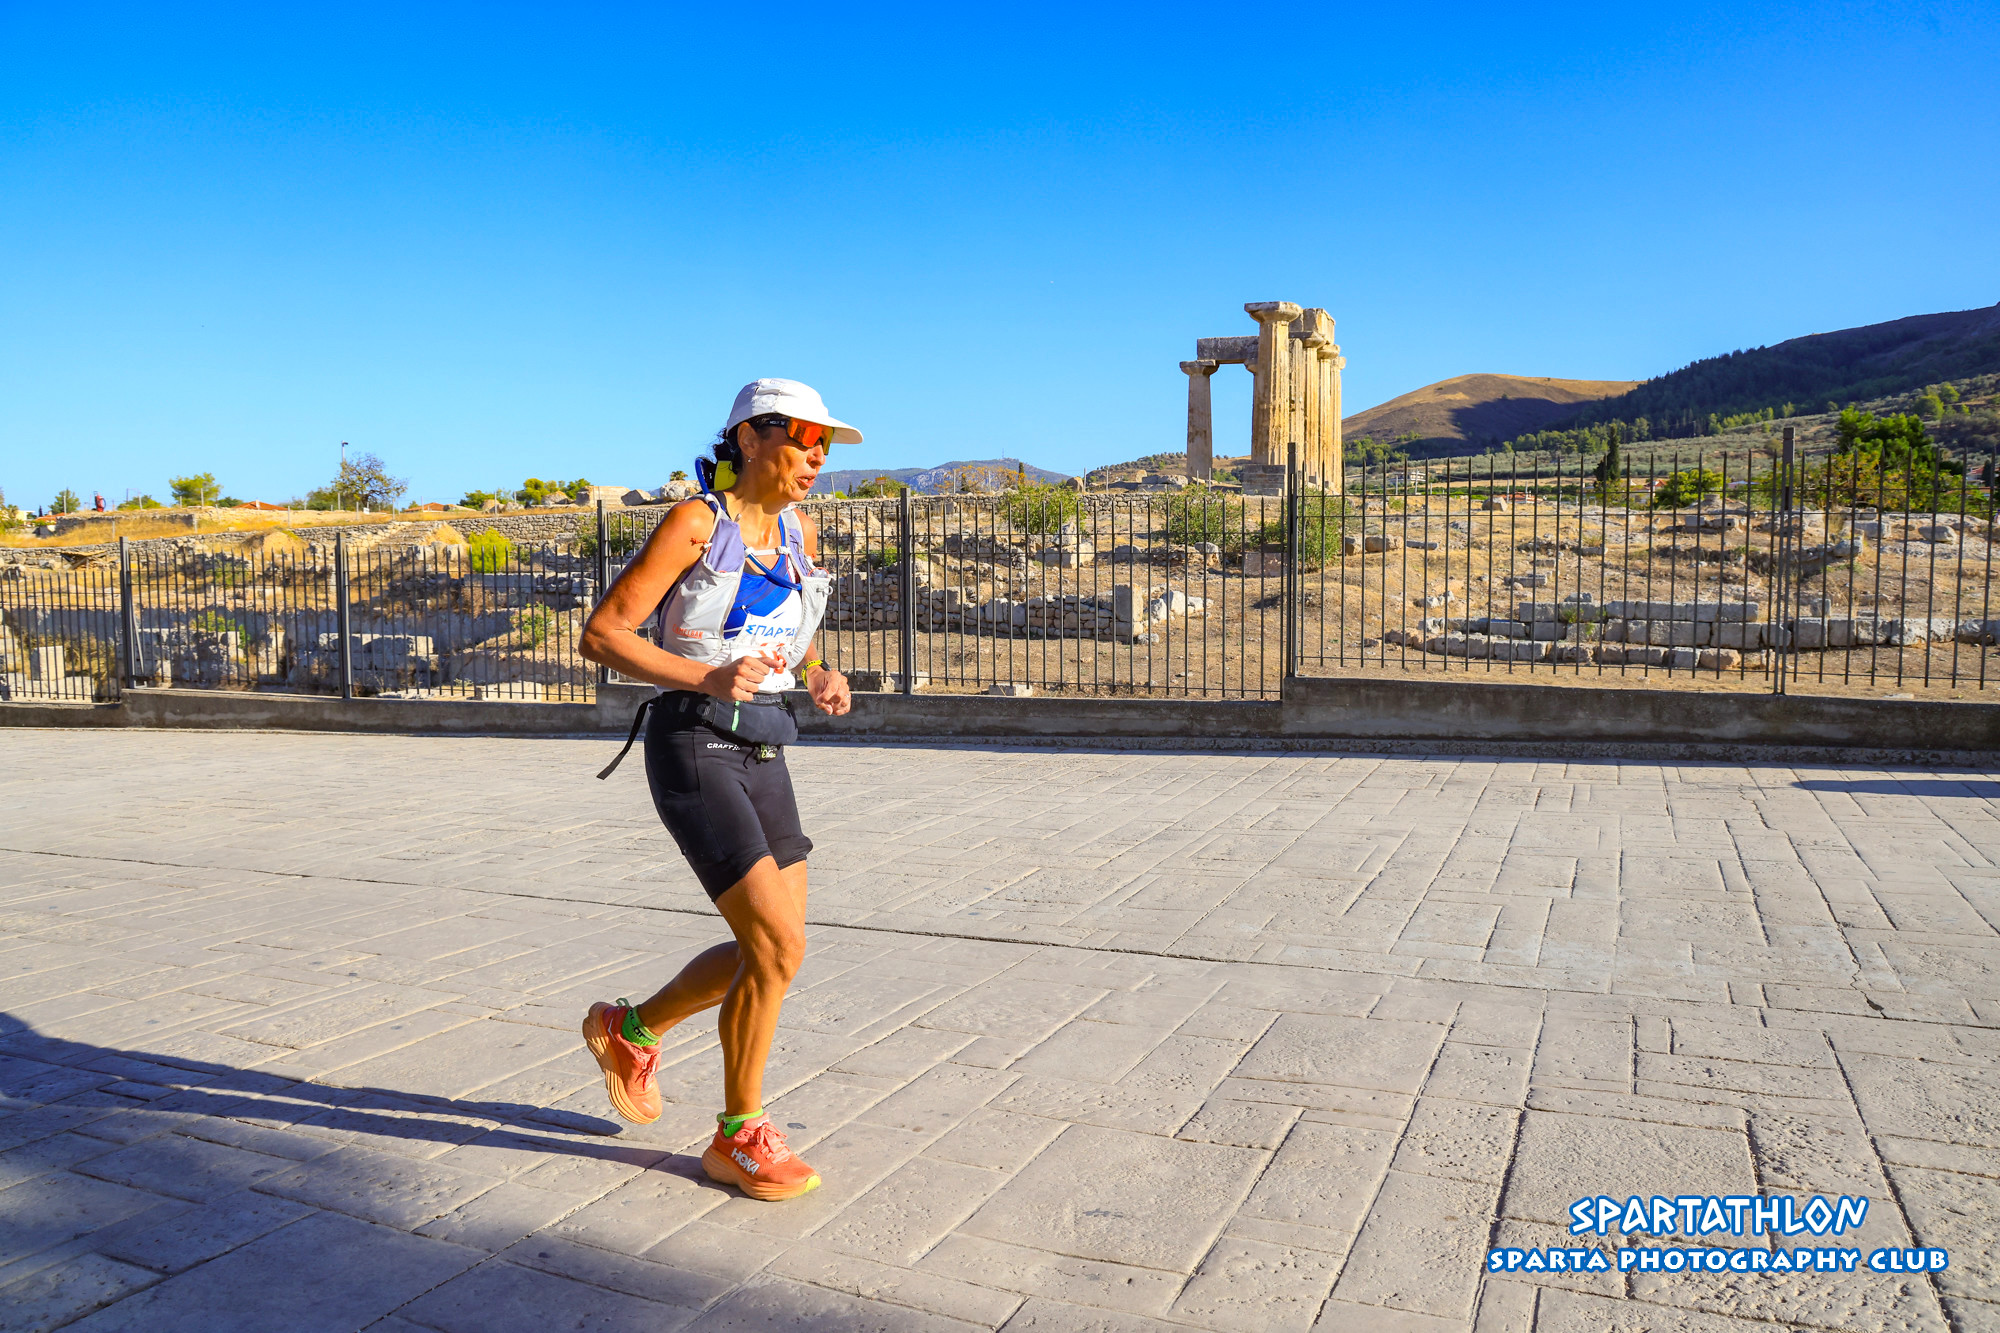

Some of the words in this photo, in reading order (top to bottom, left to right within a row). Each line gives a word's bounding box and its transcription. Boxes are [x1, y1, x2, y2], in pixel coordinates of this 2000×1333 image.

[745, 624, 799, 638] ΣΠΑΡΤΑ
[706, 742, 734, 750] CRAFT
[731, 1147, 761, 1175] HOKA
